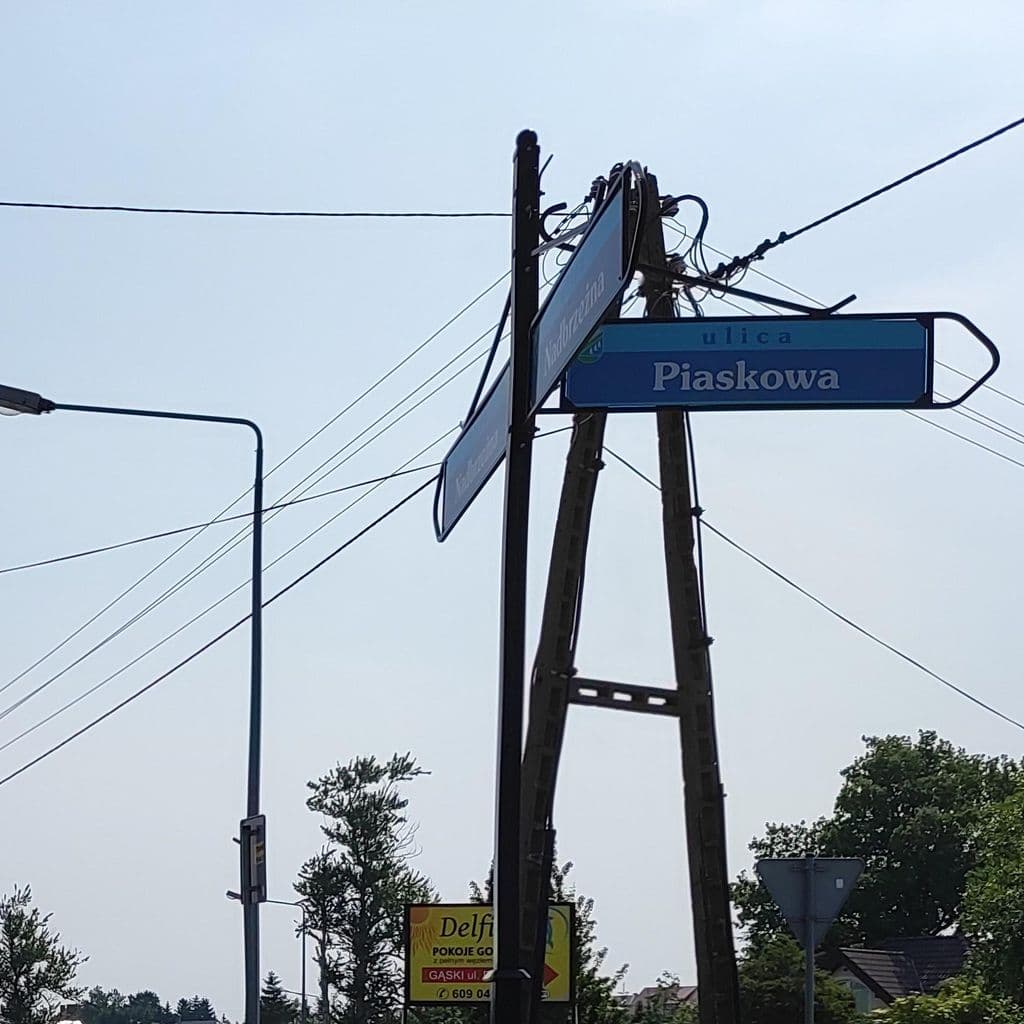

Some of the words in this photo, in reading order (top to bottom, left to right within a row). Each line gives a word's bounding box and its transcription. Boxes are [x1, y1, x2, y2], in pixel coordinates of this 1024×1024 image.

[702, 326, 793, 346] ulica
[652, 360, 841, 392] Piaskowa
[439, 913, 494, 944] Delfi
[432, 946, 475, 957] POKOJE
[477, 946, 494, 957] GO
[428, 970, 464, 982] GĄSKI
[452, 988, 473, 999] 609
[476, 988, 491, 999] 04
